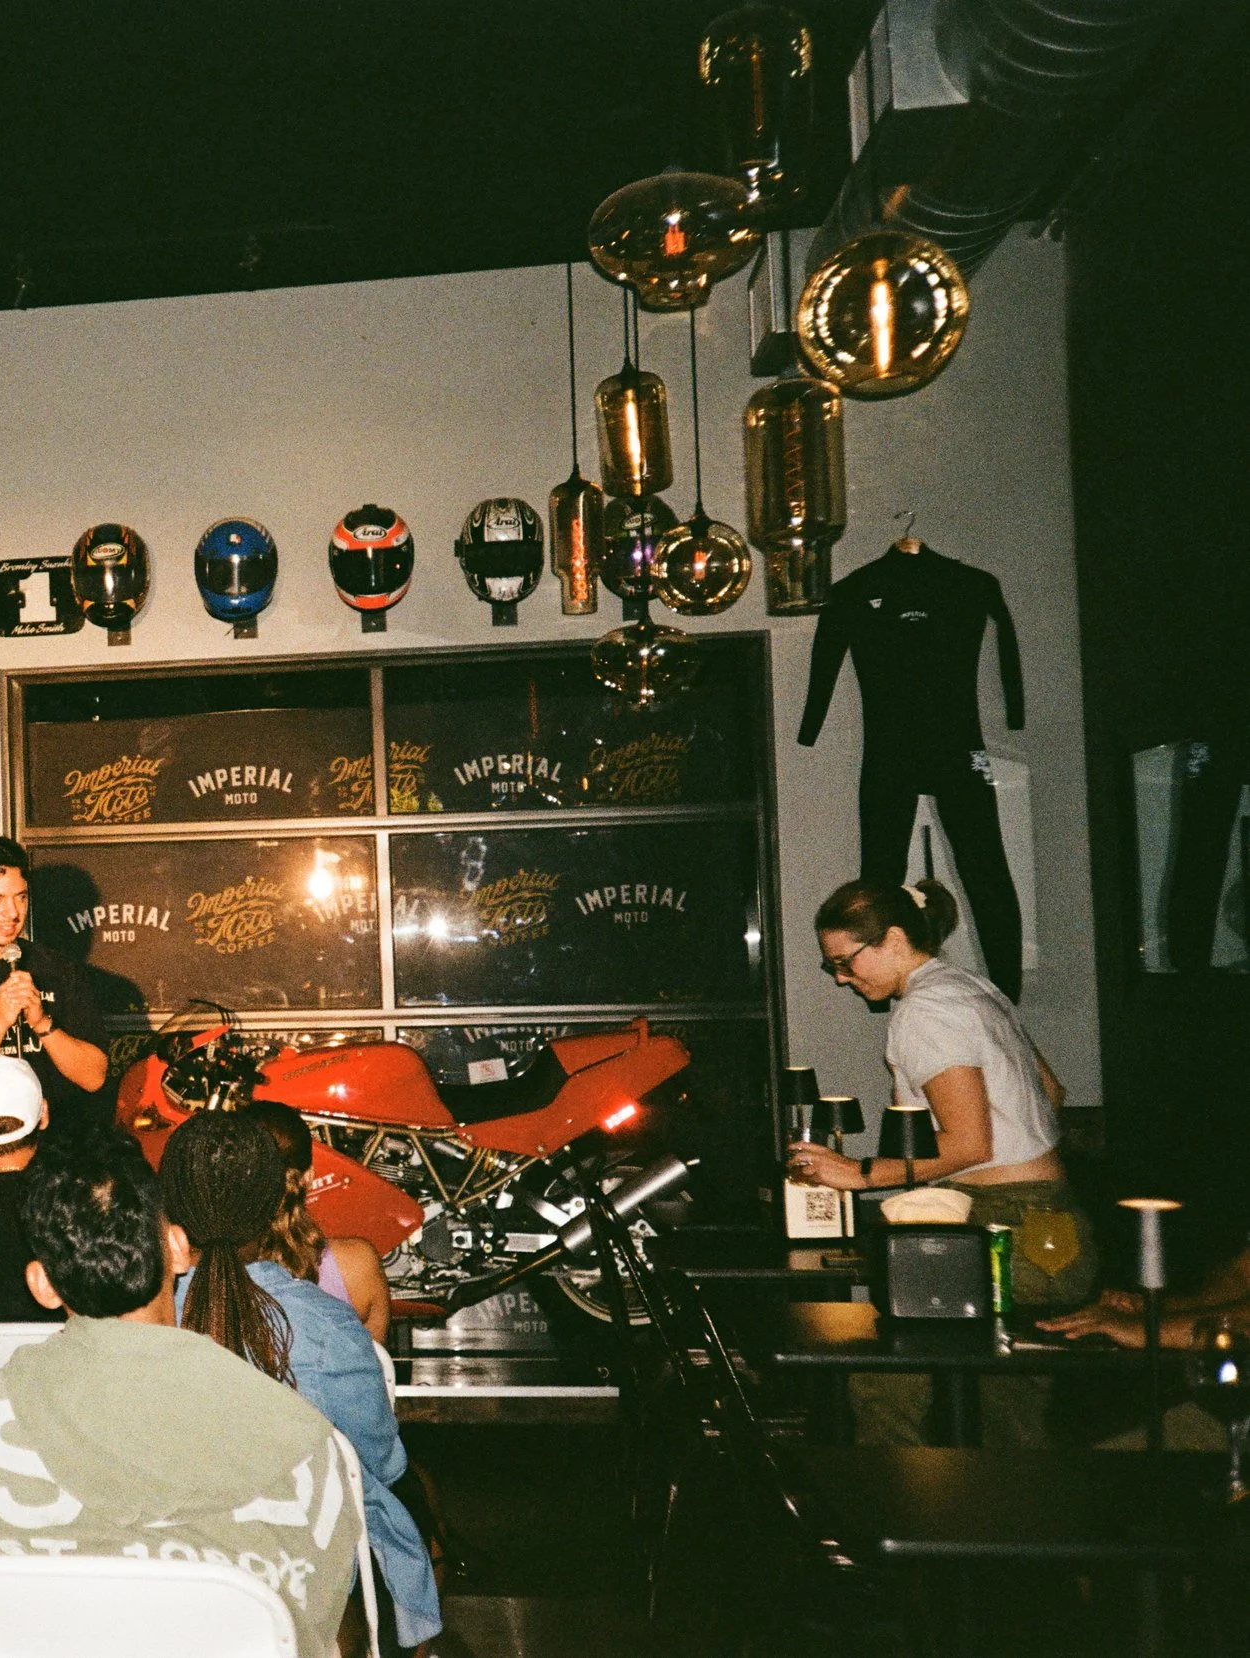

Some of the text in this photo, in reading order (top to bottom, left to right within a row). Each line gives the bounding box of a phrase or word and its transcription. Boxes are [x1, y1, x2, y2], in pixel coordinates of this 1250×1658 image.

[358, 526, 383, 537] Arai
[19, 571, 57, 623] 1
[62, 754, 165, 798] Imperial
[188, 765, 294, 798] IMPERIAL
[453, 753, 562, 787] IMPERIAL
[225, 792, 258, 805] MOTO
[491, 781, 525, 794] MOTO
[73, 784, 152, 821] Moto
[185, 876, 288, 922] Imperial
[575, 883, 687, 915] IMPERIAL
[67, 903, 171, 934] IMPERIAL
[350, 919, 377, 934] MOT
[614, 911, 649, 924] MOTO
[102, 930, 136, 943] MOTO
[216, 931, 277, 955] COFFEE
[513, 1321, 548, 1333] MOTO
